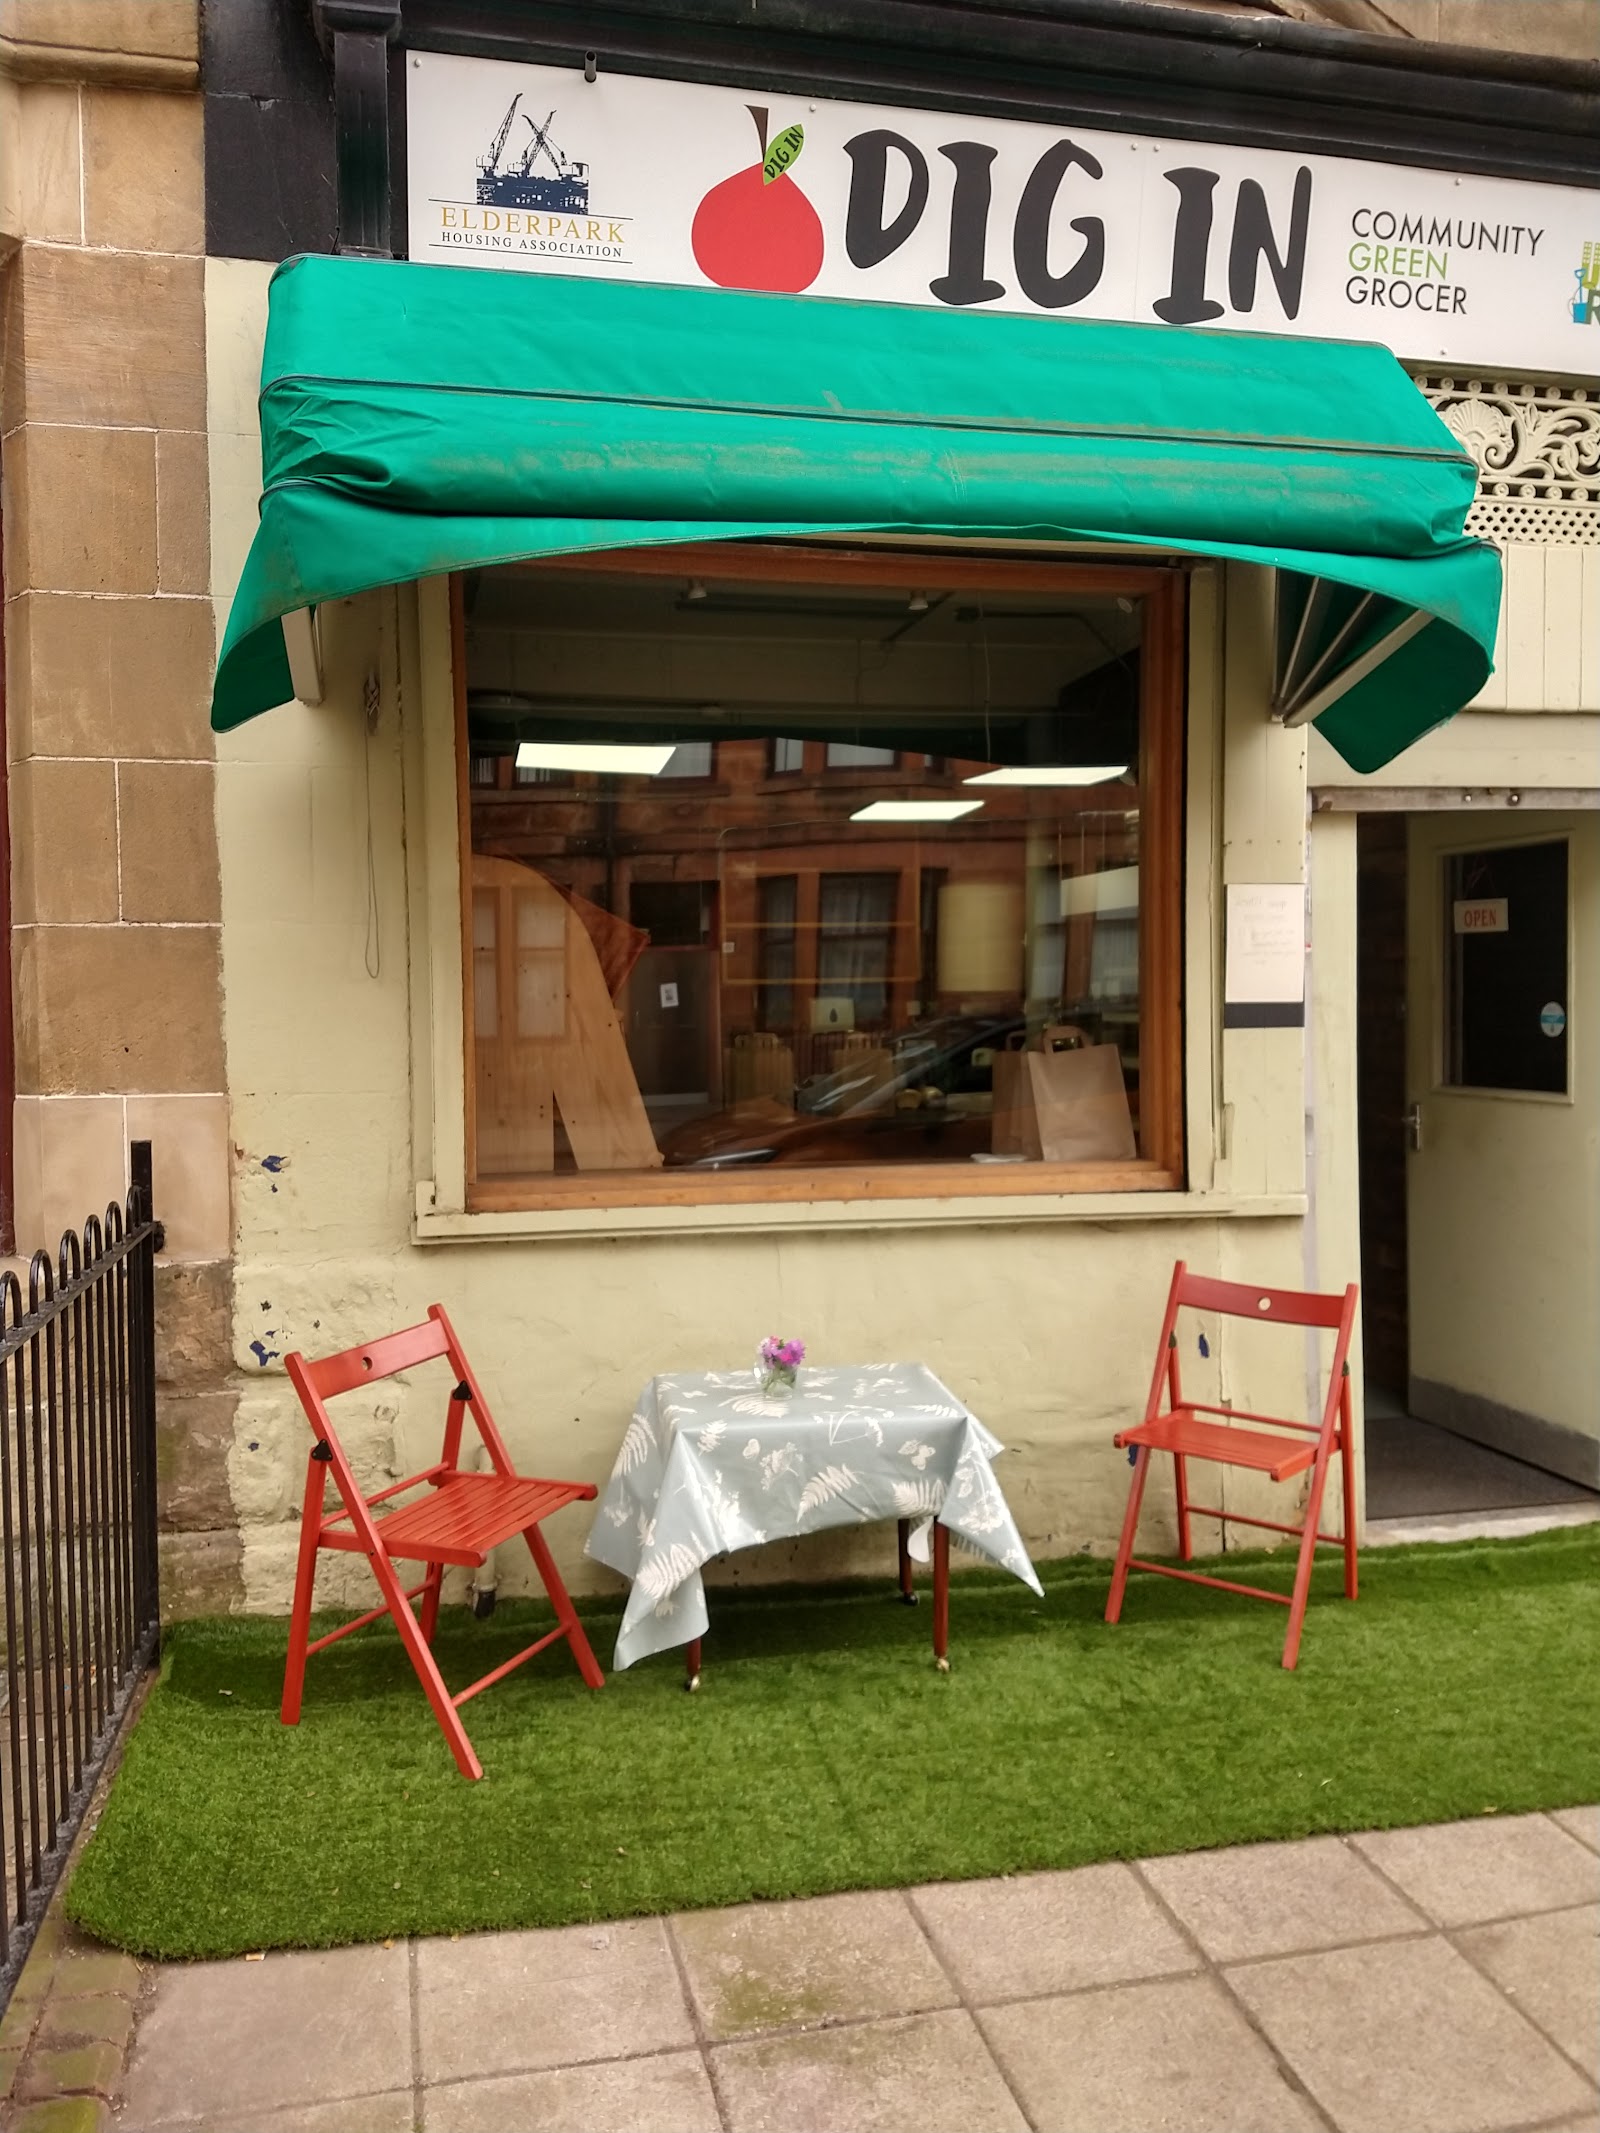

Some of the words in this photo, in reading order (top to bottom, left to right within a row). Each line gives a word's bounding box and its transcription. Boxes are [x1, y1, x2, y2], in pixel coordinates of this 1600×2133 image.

[764, 147, 790, 178] DIG
[784, 126, 804, 152] IN
[441, 206, 625, 244] ELDERPARK
[842, 128, 1106, 309] DIG
[1152, 165, 1312, 325] IN
[1352, 208, 1545, 257] COMMUNITY
[442, 232, 512, 248] HOUSING
[519, 239, 622, 258] ASSOCIATION
[1348, 242, 1448, 280] GREEN
[1345, 275, 1468, 315] GROCER
[1463, 908, 1497, 928] OPEN
